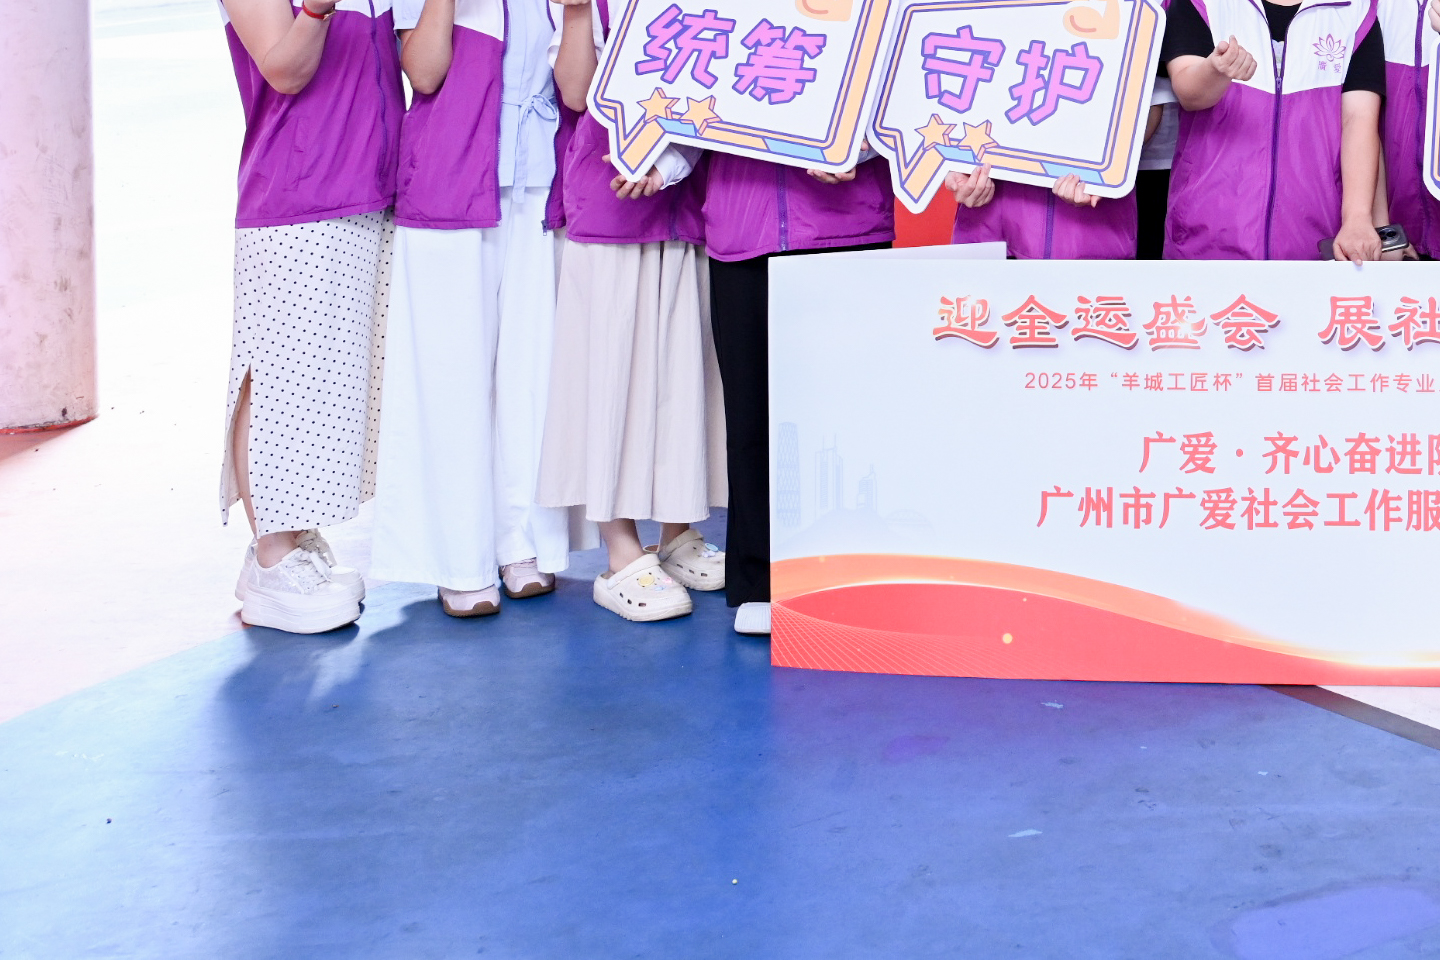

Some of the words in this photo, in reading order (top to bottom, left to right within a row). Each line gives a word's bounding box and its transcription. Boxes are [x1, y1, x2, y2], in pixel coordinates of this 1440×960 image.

[635, 3, 827, 105] 统筹
[922, 25, 1104, 127] 守护
[932, 292, 1281, 352] 迎全运盛会
